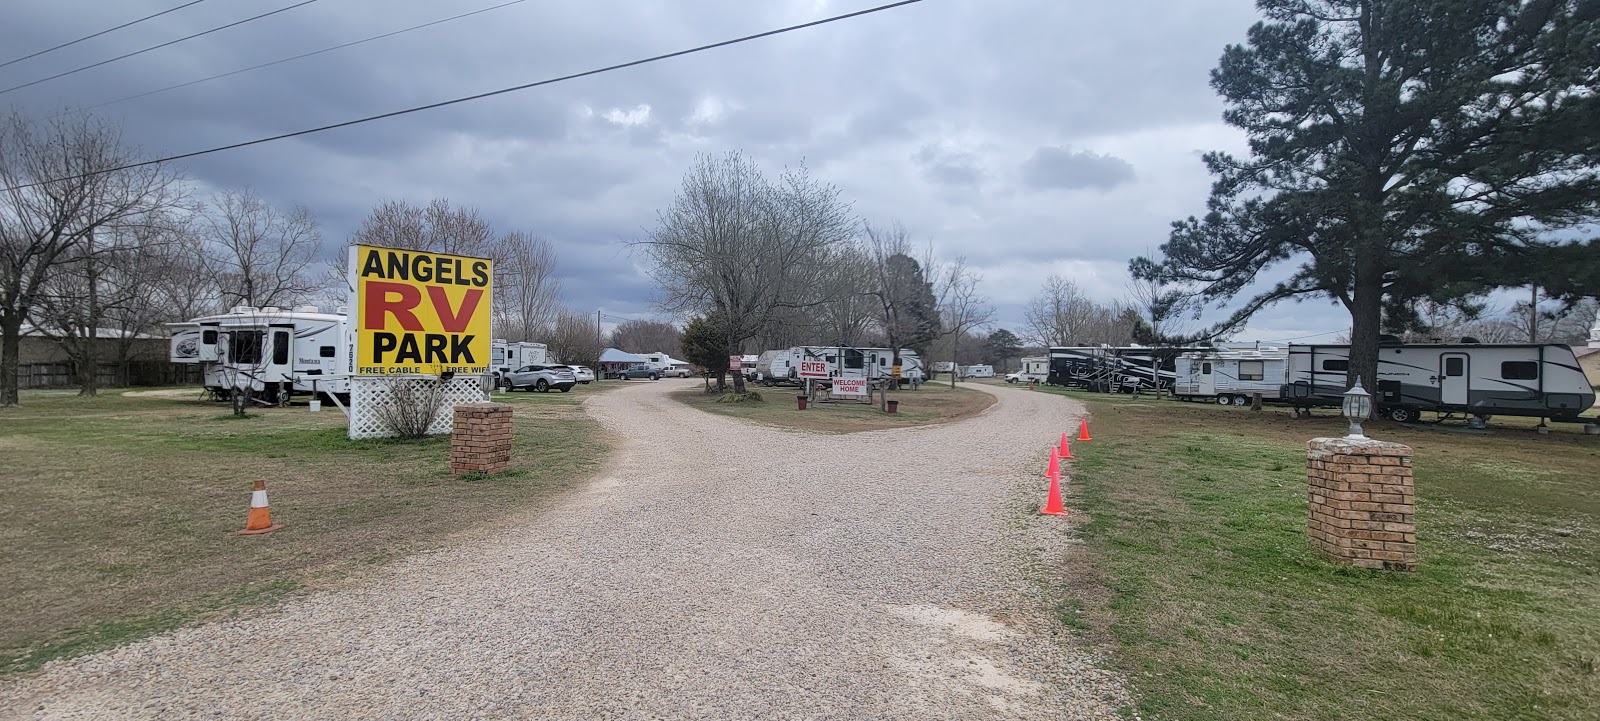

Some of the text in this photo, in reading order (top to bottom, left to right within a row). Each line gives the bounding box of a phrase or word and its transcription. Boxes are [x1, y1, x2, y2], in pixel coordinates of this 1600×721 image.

[361, 249, 489, 287] ANGELS
[364, 280, 484, 333] RV
[373, 332, 475, 364] PARK
[298, 357, 321, 365] Montana
[389, 366, 421, 374] CABLE
[446, 366, 468, 374] FREE
[802, 362, 826, 372] ENTER
